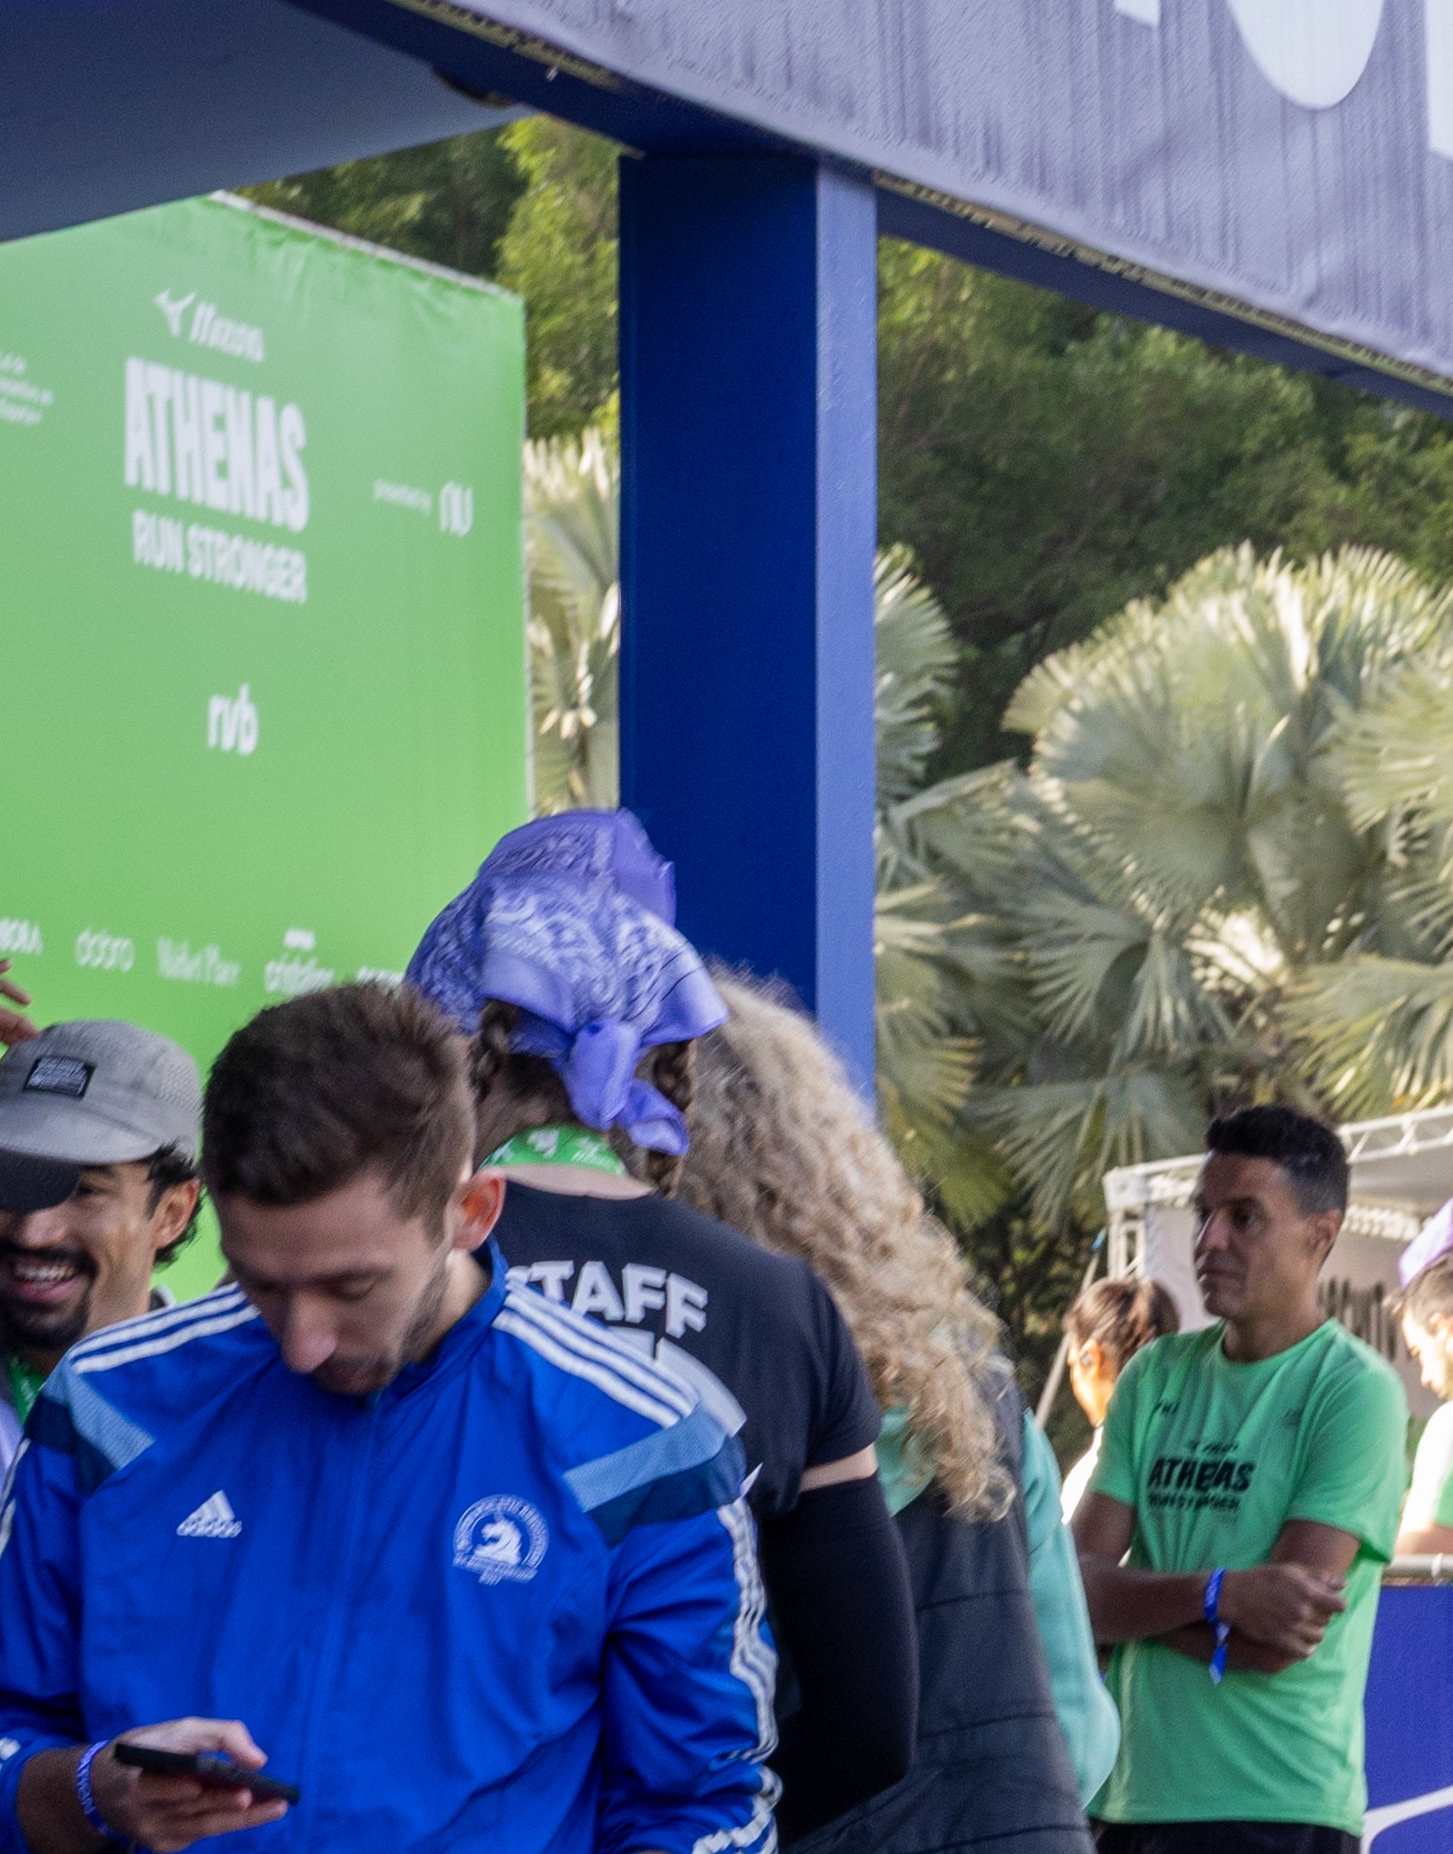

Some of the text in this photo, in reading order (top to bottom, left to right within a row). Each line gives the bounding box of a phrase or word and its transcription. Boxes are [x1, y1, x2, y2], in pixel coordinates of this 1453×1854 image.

[124, 355, 309, 534] ATHENAS
[132, 508, 308, 605] RUN STRONGER
[1147, 1456, 1257, 1492] ATHEAS
